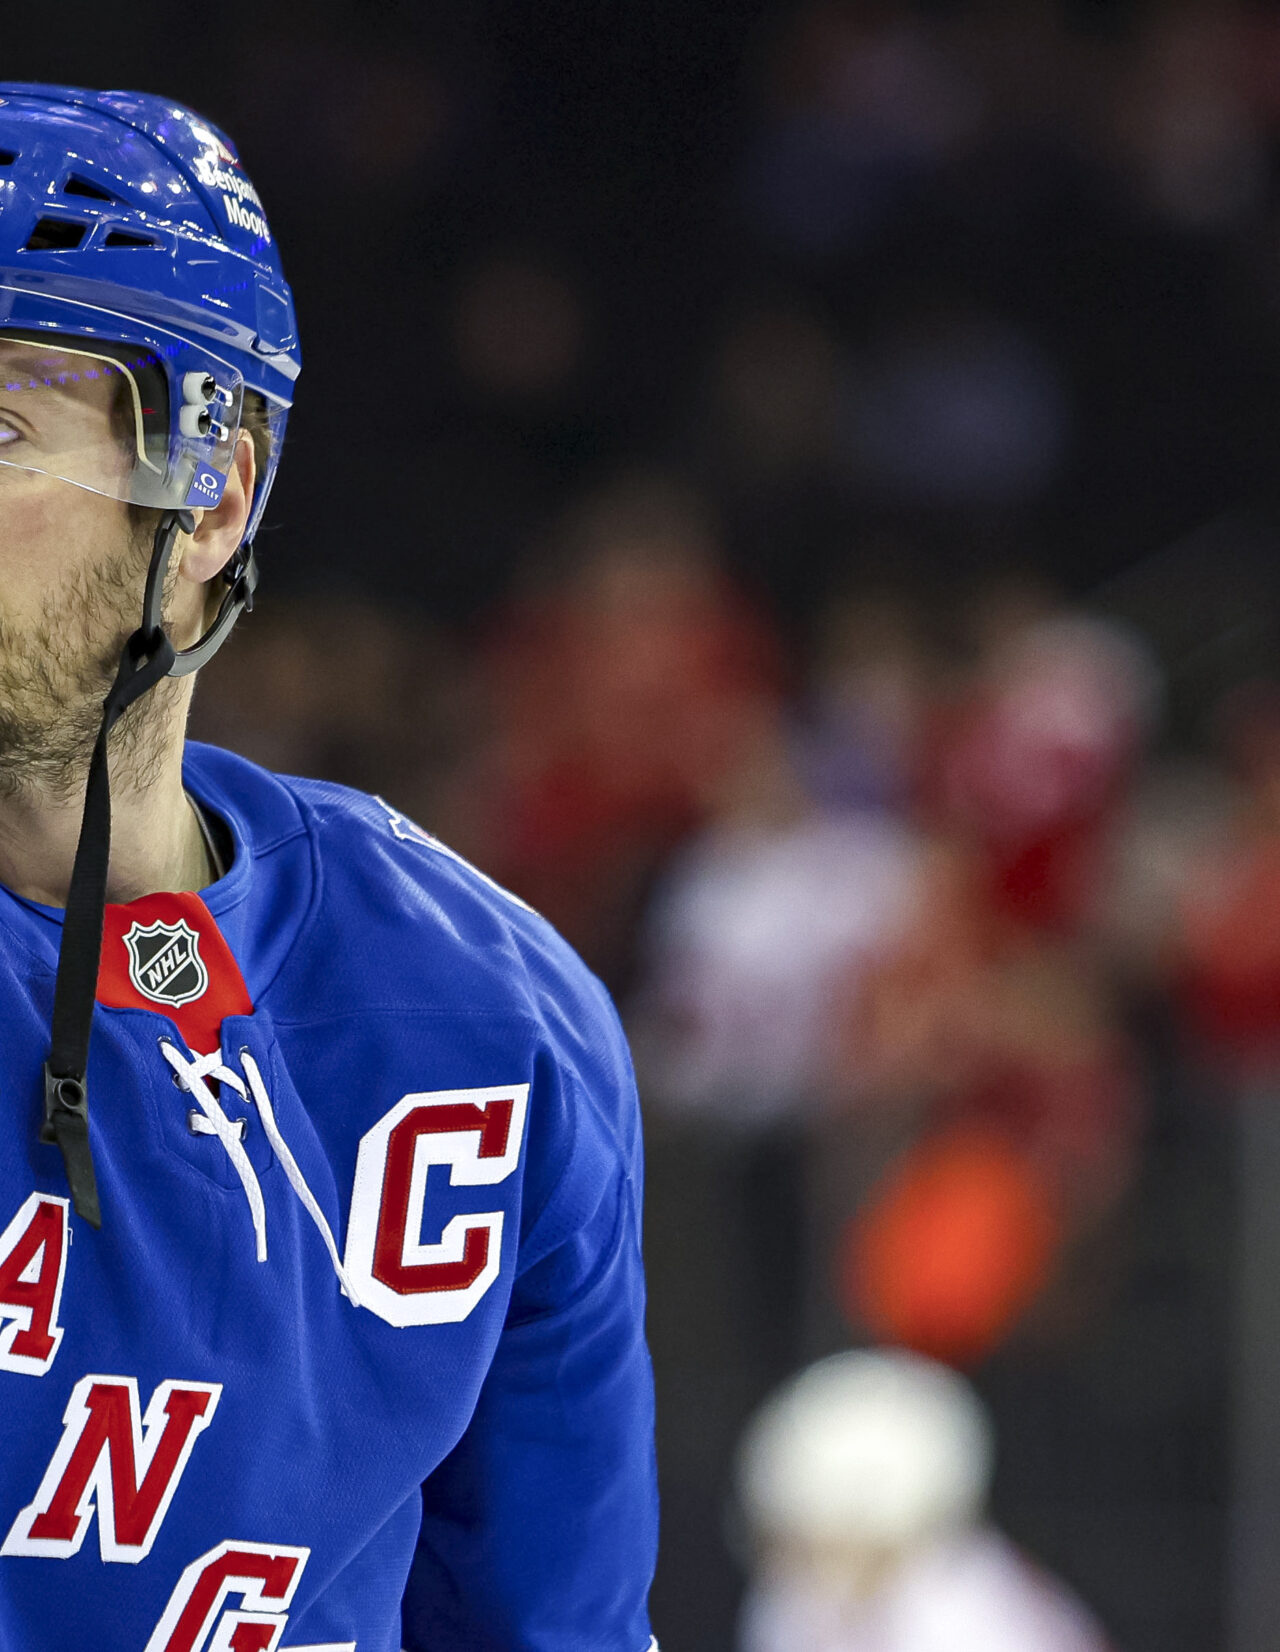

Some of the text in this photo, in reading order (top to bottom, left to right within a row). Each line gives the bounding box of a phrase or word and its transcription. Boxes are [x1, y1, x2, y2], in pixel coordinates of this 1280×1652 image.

[193, 481, 219, 500] OAKLEY
[147, 943, 187, 989] NHL
[341, 1083, 530, 1328] C
